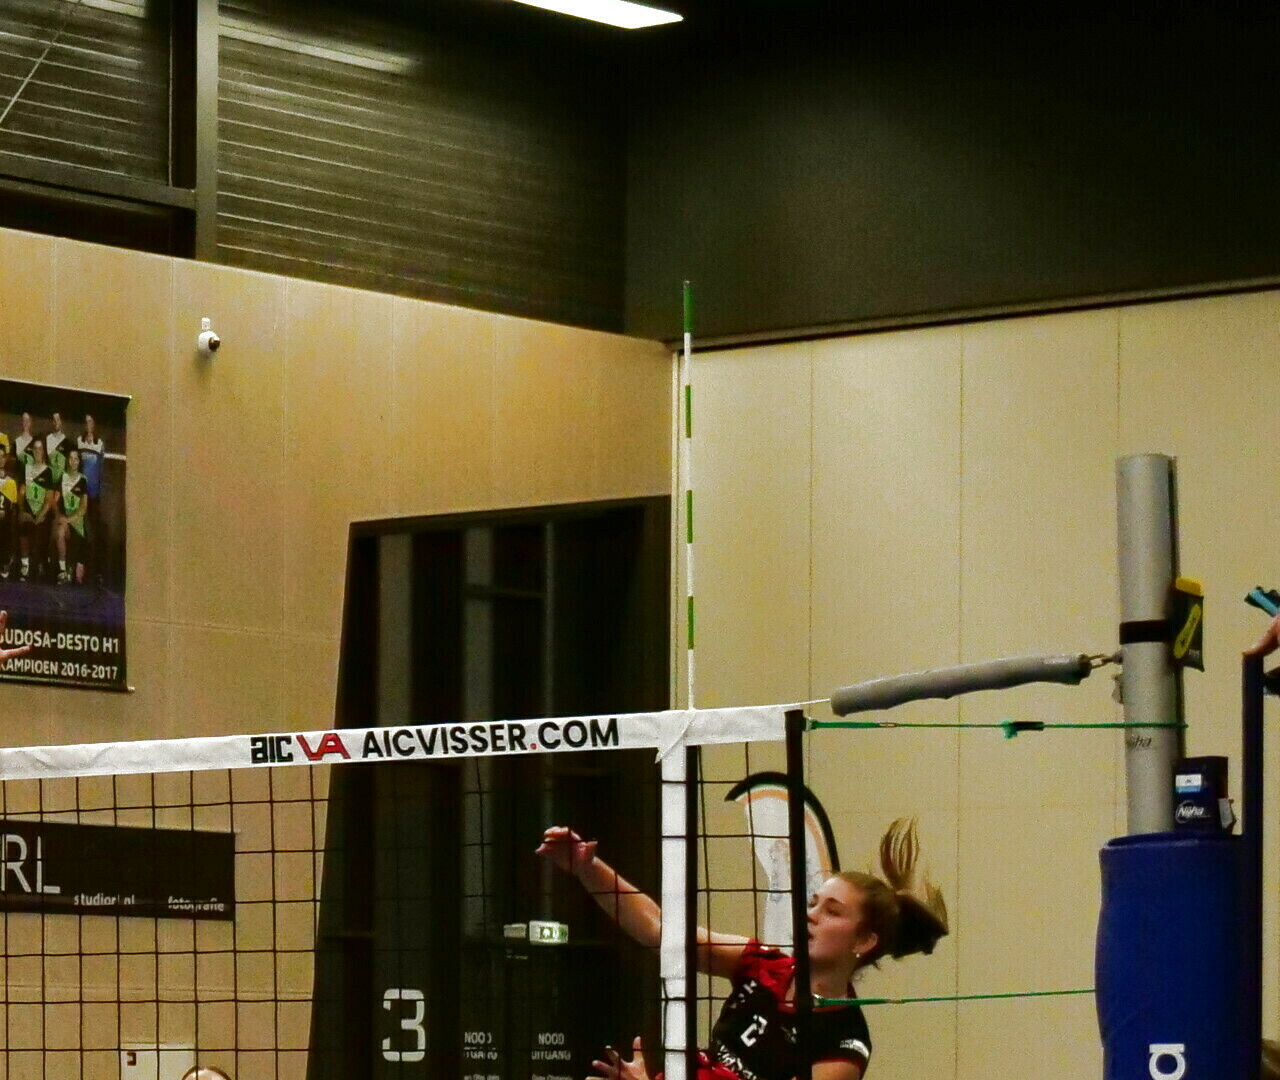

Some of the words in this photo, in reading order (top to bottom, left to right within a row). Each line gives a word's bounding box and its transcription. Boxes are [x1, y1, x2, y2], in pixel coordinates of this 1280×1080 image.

[103, 636, 119, 654] H1
[60, 661, 119, 680] 2016-2017
[361, 718, 620, 759] AICVISSER.COM
[382, 988, 426, 1062] 3
[740, 1014, 768, 1047] 2
[538, 1032, 565, 1045] NOOD
